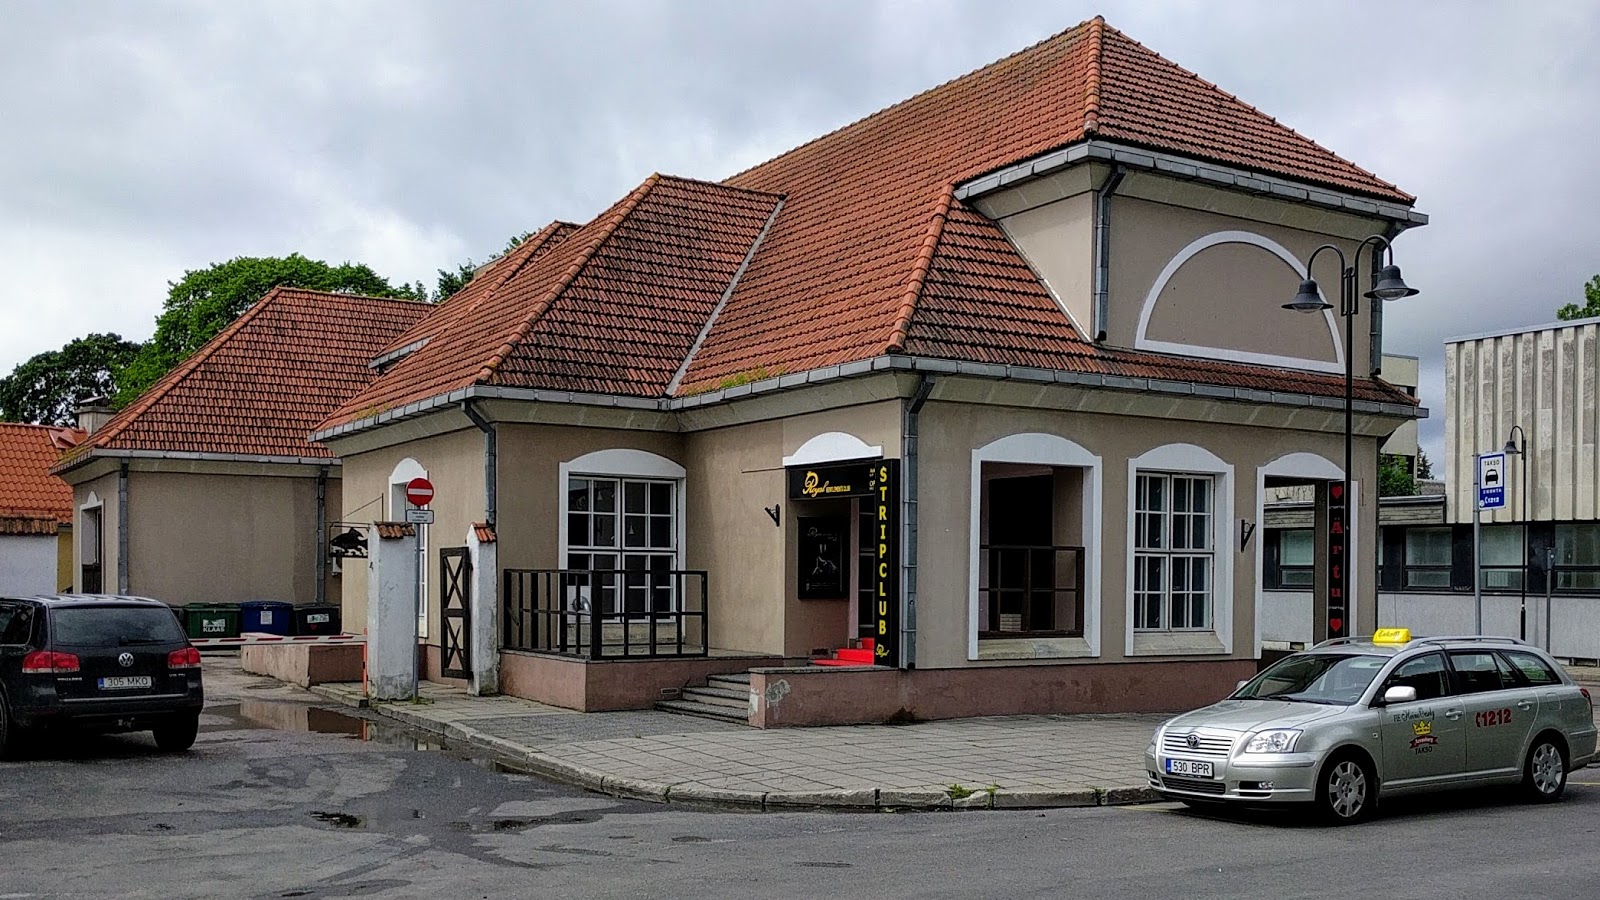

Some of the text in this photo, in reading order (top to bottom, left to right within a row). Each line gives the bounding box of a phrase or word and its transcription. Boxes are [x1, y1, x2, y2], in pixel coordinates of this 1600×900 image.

[1484, 459, 1500, 467] TAKSO
[802, 470, 830, 498] Royal
[1330, 517, 1344, 598] Ärtu
[107, 676, 148, 687] 305 MKO
[1481, 708, 1512, 727] 1212
[1414, 746, 1433, 755] TAKSO
[1173, 761, 1210, 774] 530 BPR
